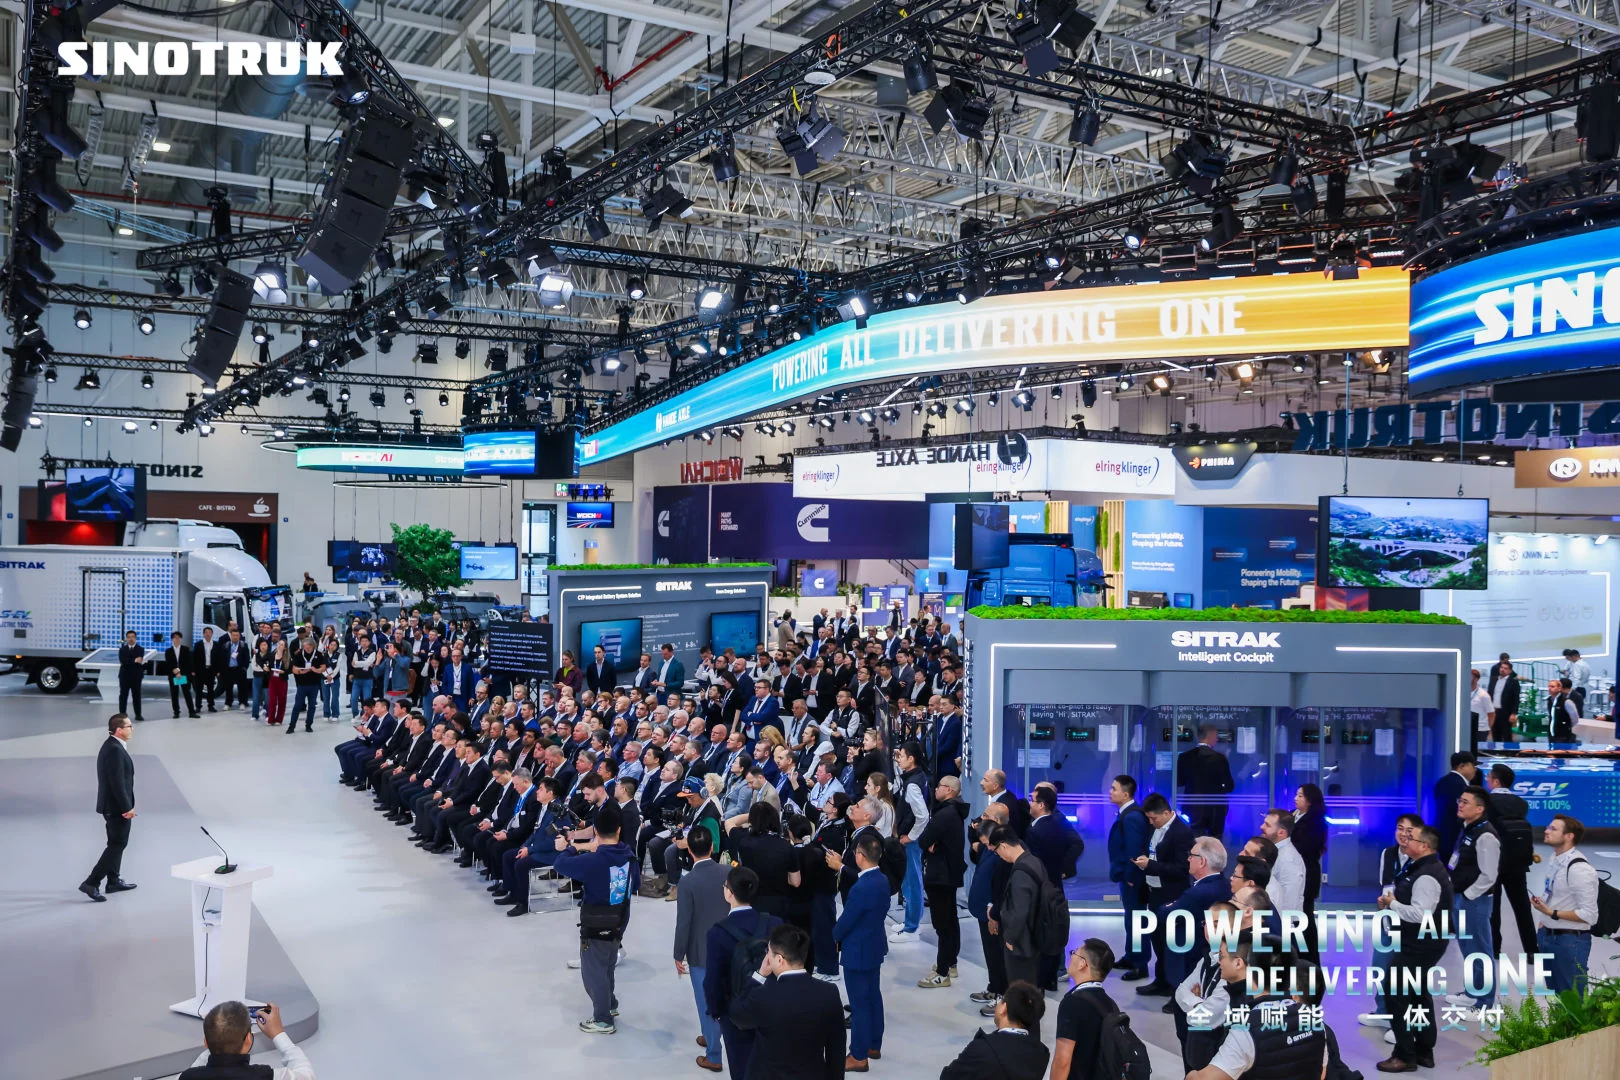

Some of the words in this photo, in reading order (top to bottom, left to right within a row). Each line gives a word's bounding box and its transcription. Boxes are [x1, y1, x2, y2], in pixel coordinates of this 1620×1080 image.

[772, 342, 828, 392] POWERING
[839, 333, 875, 371] ALL
[899, 302, 1116, 359] DELIVERING
[1158, 295, 1247, 338] ONE
[1200, 457, 1235, 467] PHINIA
[1095, 460, 1152, 476] elringklinger
[802, 469, 835, 484] elringklinger
[797, 504, 827, 529] Cummins
[1131, 532, 1160, 541] Pioneering
[1131, 539, 1154, 549] Shaping
[0, 561, 46, 570] SITRAK
[1240, 568, 1275, 579] Pioneering
[655, 581, 693, 592] SITRAK
[1240, 578, 1268, 588] Shaping
[1268, 578, 1279, 586] the
[1170, 630, 1282, 648] SITRAK
[1178, 651, 1232, 664] Intelligent
[1233, 652, 1275, 664] Cockpit
[1542, 800, 1571, 810] 100%
[1292, 1030, 1313, 1042] SITRAK
